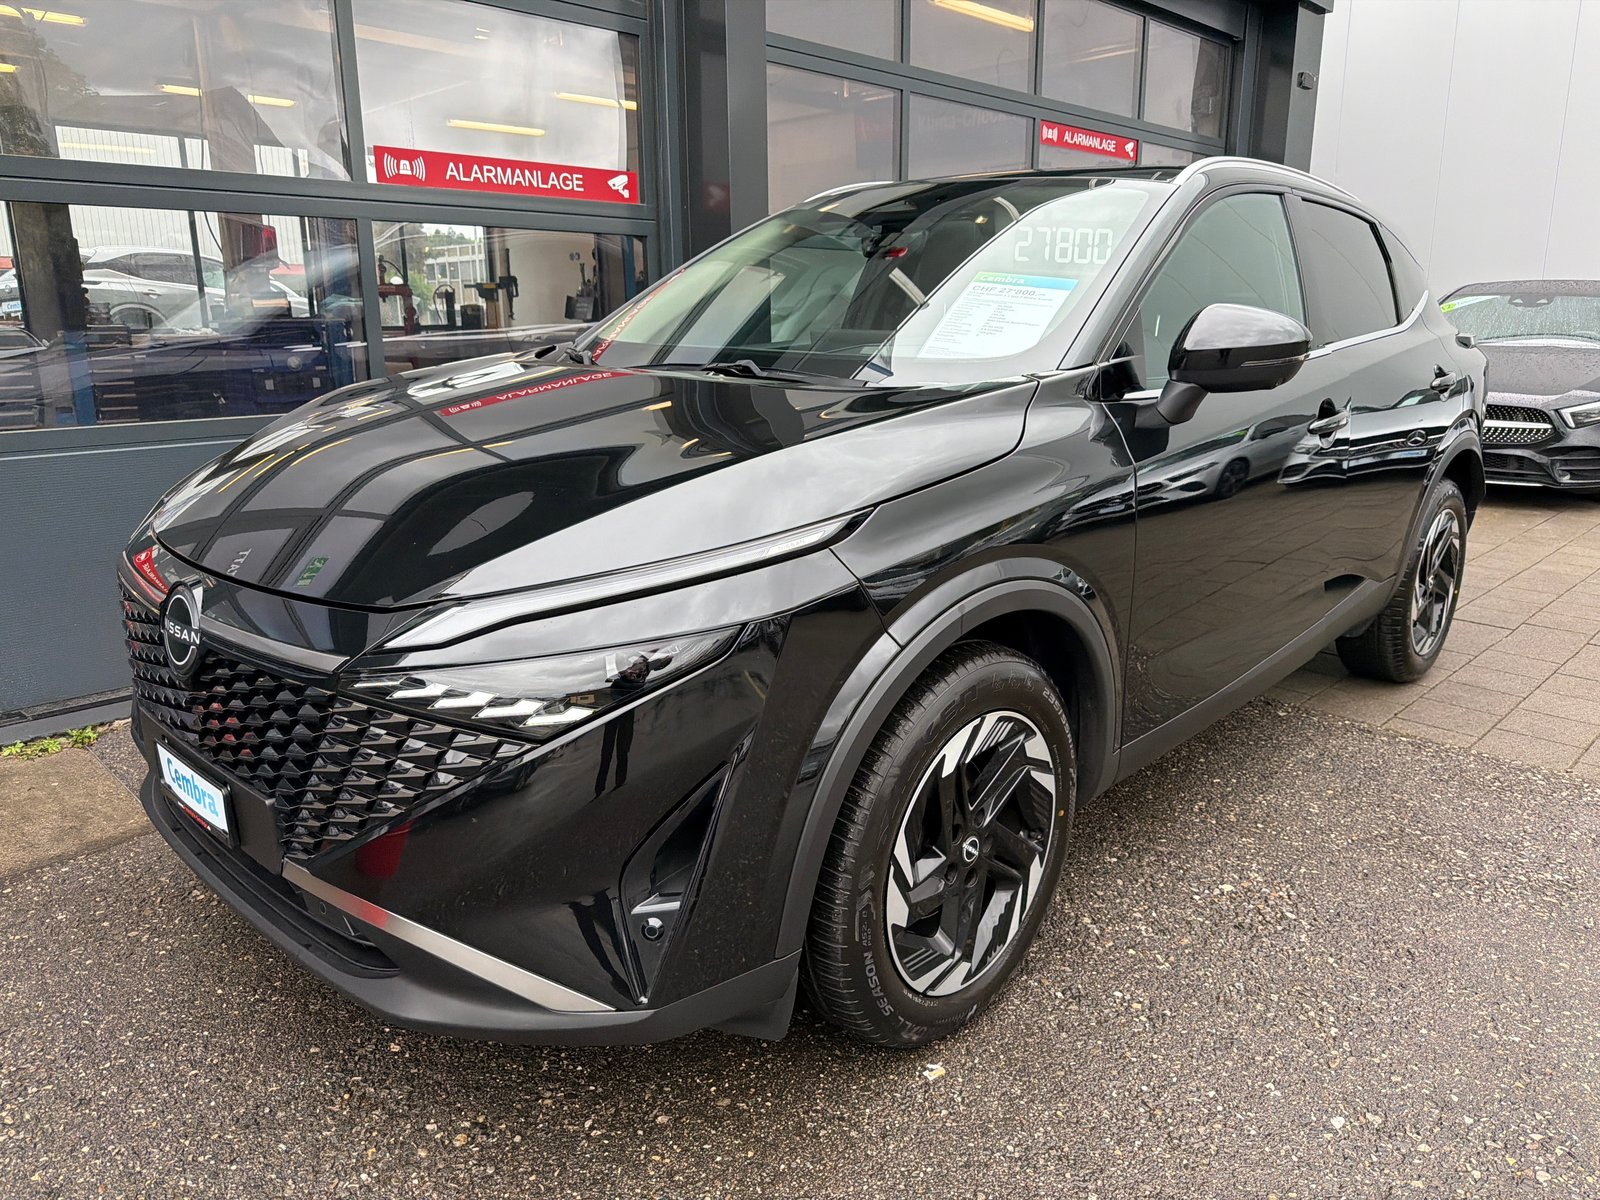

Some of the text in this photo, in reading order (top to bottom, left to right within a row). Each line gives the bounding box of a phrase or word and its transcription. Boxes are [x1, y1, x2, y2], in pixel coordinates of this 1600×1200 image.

[1063, 130, 1116, 152] ALARMANLAGE
[446, 162, 584, 191] ALARMANLAGE
[972, 285, 998, 293] CHF
[979, 274, 1025, 284] Cembra
[166, 757, 219, 817] Cembra
[863, 951, 894, 1017] SEASON
